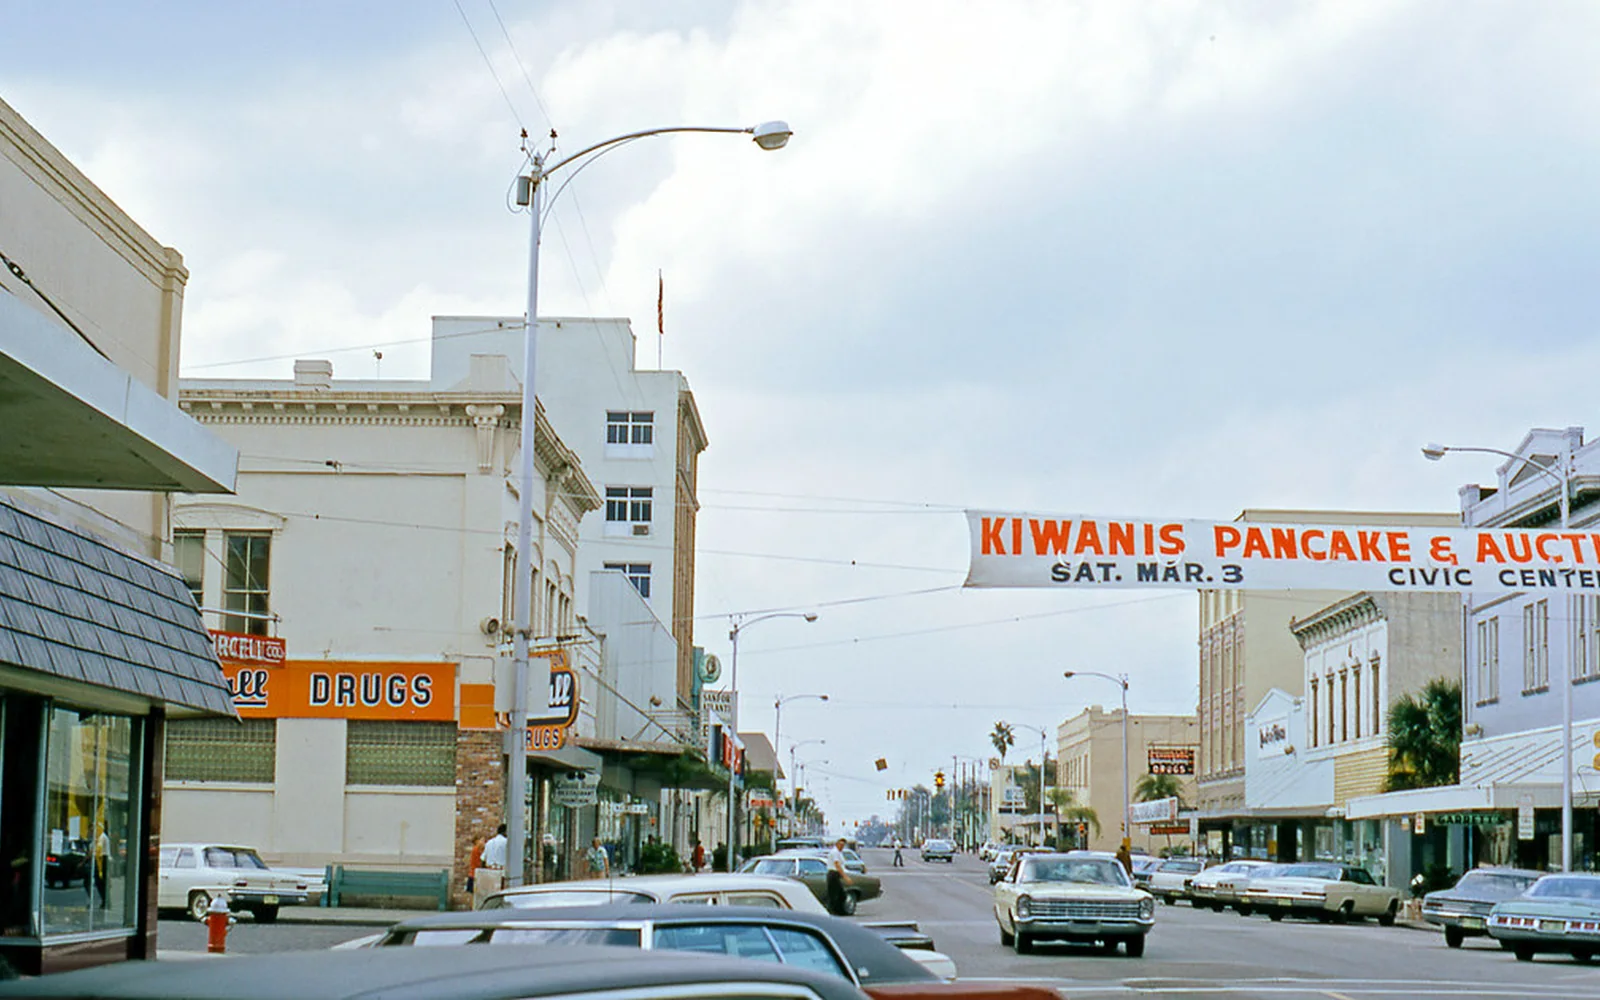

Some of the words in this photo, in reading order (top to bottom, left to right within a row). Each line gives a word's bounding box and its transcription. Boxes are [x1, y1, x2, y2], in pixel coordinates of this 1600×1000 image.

[981, 517, 1186, 556] KIWANIS
[1214, 526, 1411, 562] PANCAKE
[1430, 537, 1459, 565] &
[1051, 562, 1122, 583] SAT.
[1221, 564, 1244, 583] 3
[1388, 568, 1473, 585] CIVIC
[1499, 569, 1600, 588] CENTE
[309, 672, 433, 707] DRUGS
[526, 728, 560, 748] RUGS
